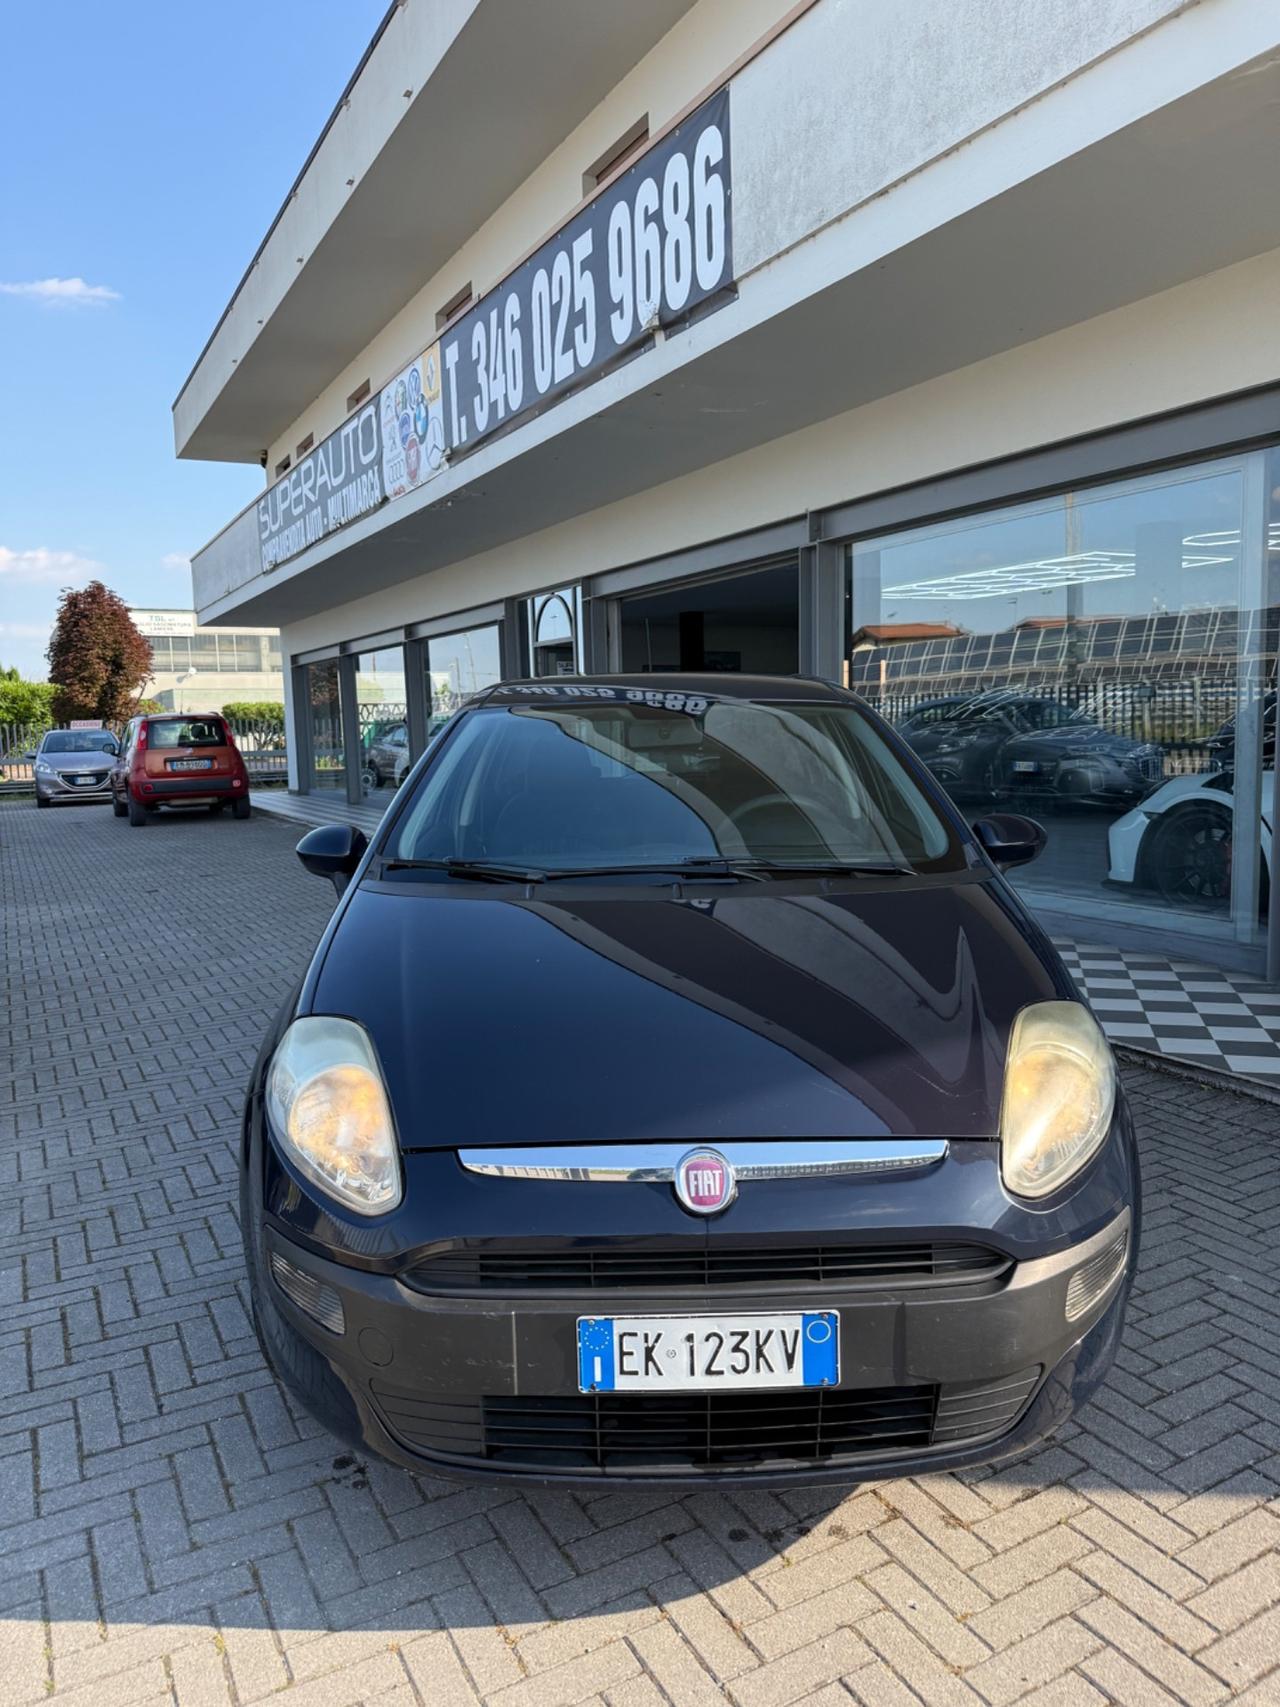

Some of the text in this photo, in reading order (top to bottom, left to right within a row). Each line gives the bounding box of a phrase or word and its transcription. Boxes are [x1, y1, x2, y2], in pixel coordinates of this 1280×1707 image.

[445, 124, 726, 448] T. 346 025 9686
[259, 404, 377, 540] SUPERAUTO
[327, 465, 381, 531] MULTIMARCA
[688, 1169, 723, 1198] FIAT
[618, 1328, 800, 1377] EK 123KV
